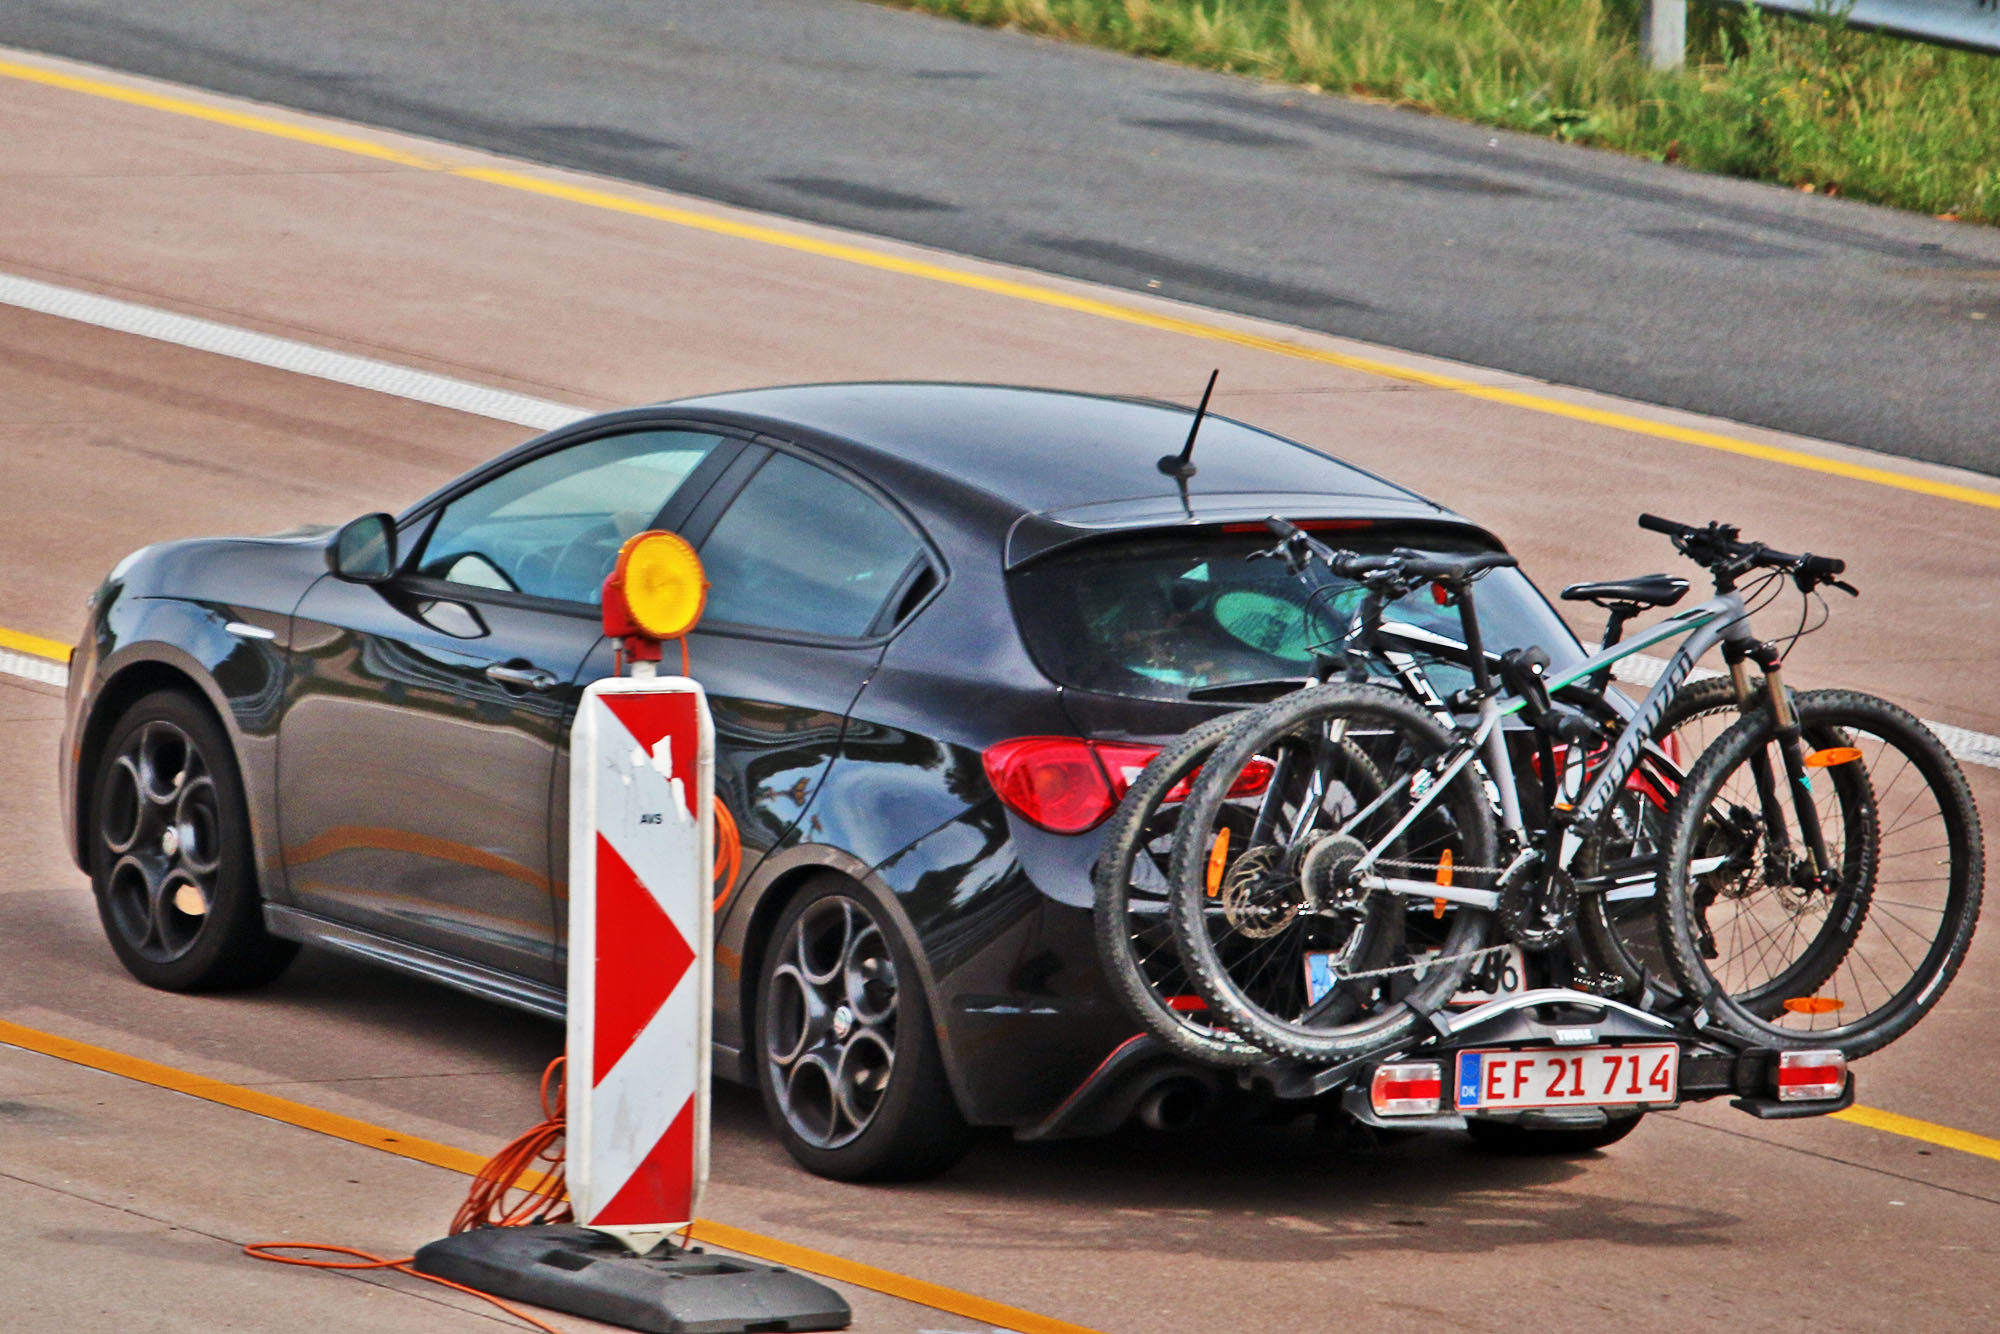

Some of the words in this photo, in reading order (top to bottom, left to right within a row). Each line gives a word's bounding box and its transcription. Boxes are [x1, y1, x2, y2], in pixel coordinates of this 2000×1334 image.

[1486, 1060, 1535, 1100] EF
[1545, 1057, 1586, 1098] 21
[1602, 1054, 1670, 1095] 714
[1461, 1086, 1477, 1098] DK
